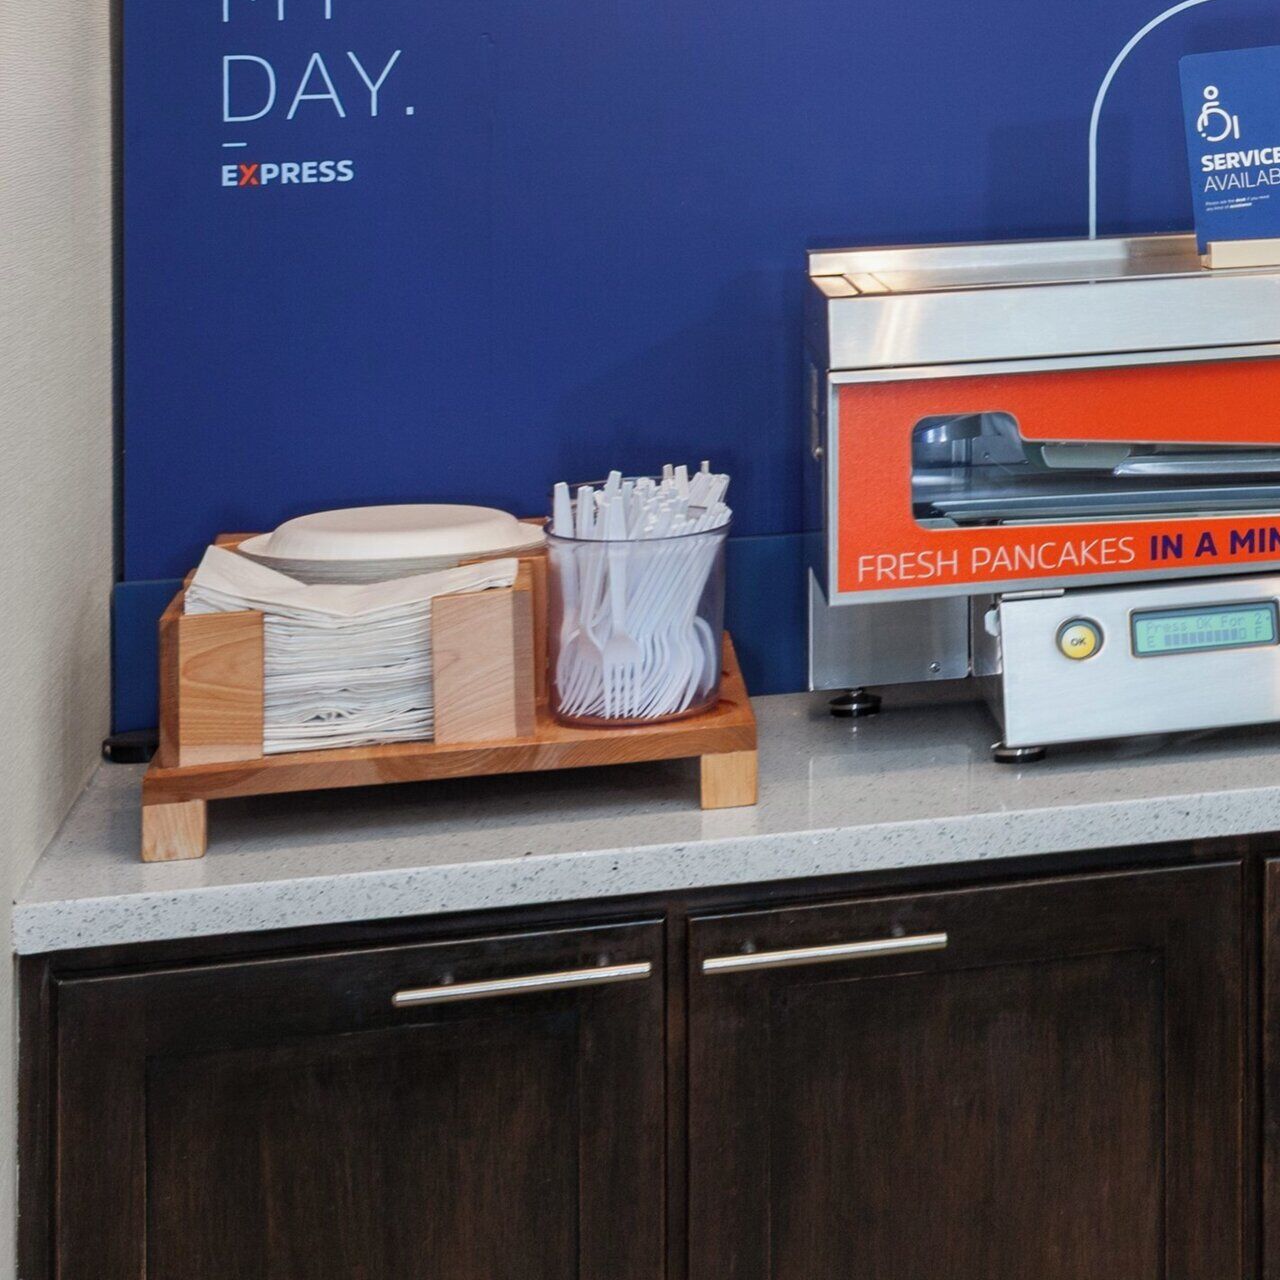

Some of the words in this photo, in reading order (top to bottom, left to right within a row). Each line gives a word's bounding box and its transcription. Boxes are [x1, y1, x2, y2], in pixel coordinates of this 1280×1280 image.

[221, 48, 416, 123] DAY.
[221, 159, 355, 187] EXPRESS
[858, 549, 959, 583] FRESH
[971, 536, 1137, 575] PANCAKES
[1150, 533, 1184, 561] IN
[1194, 531, 1218, 558] A
[1146, 621, 1188, 633] Press
[1197, 616, 1213, 629] OK
[1070, 637, 1087, 647] OK
